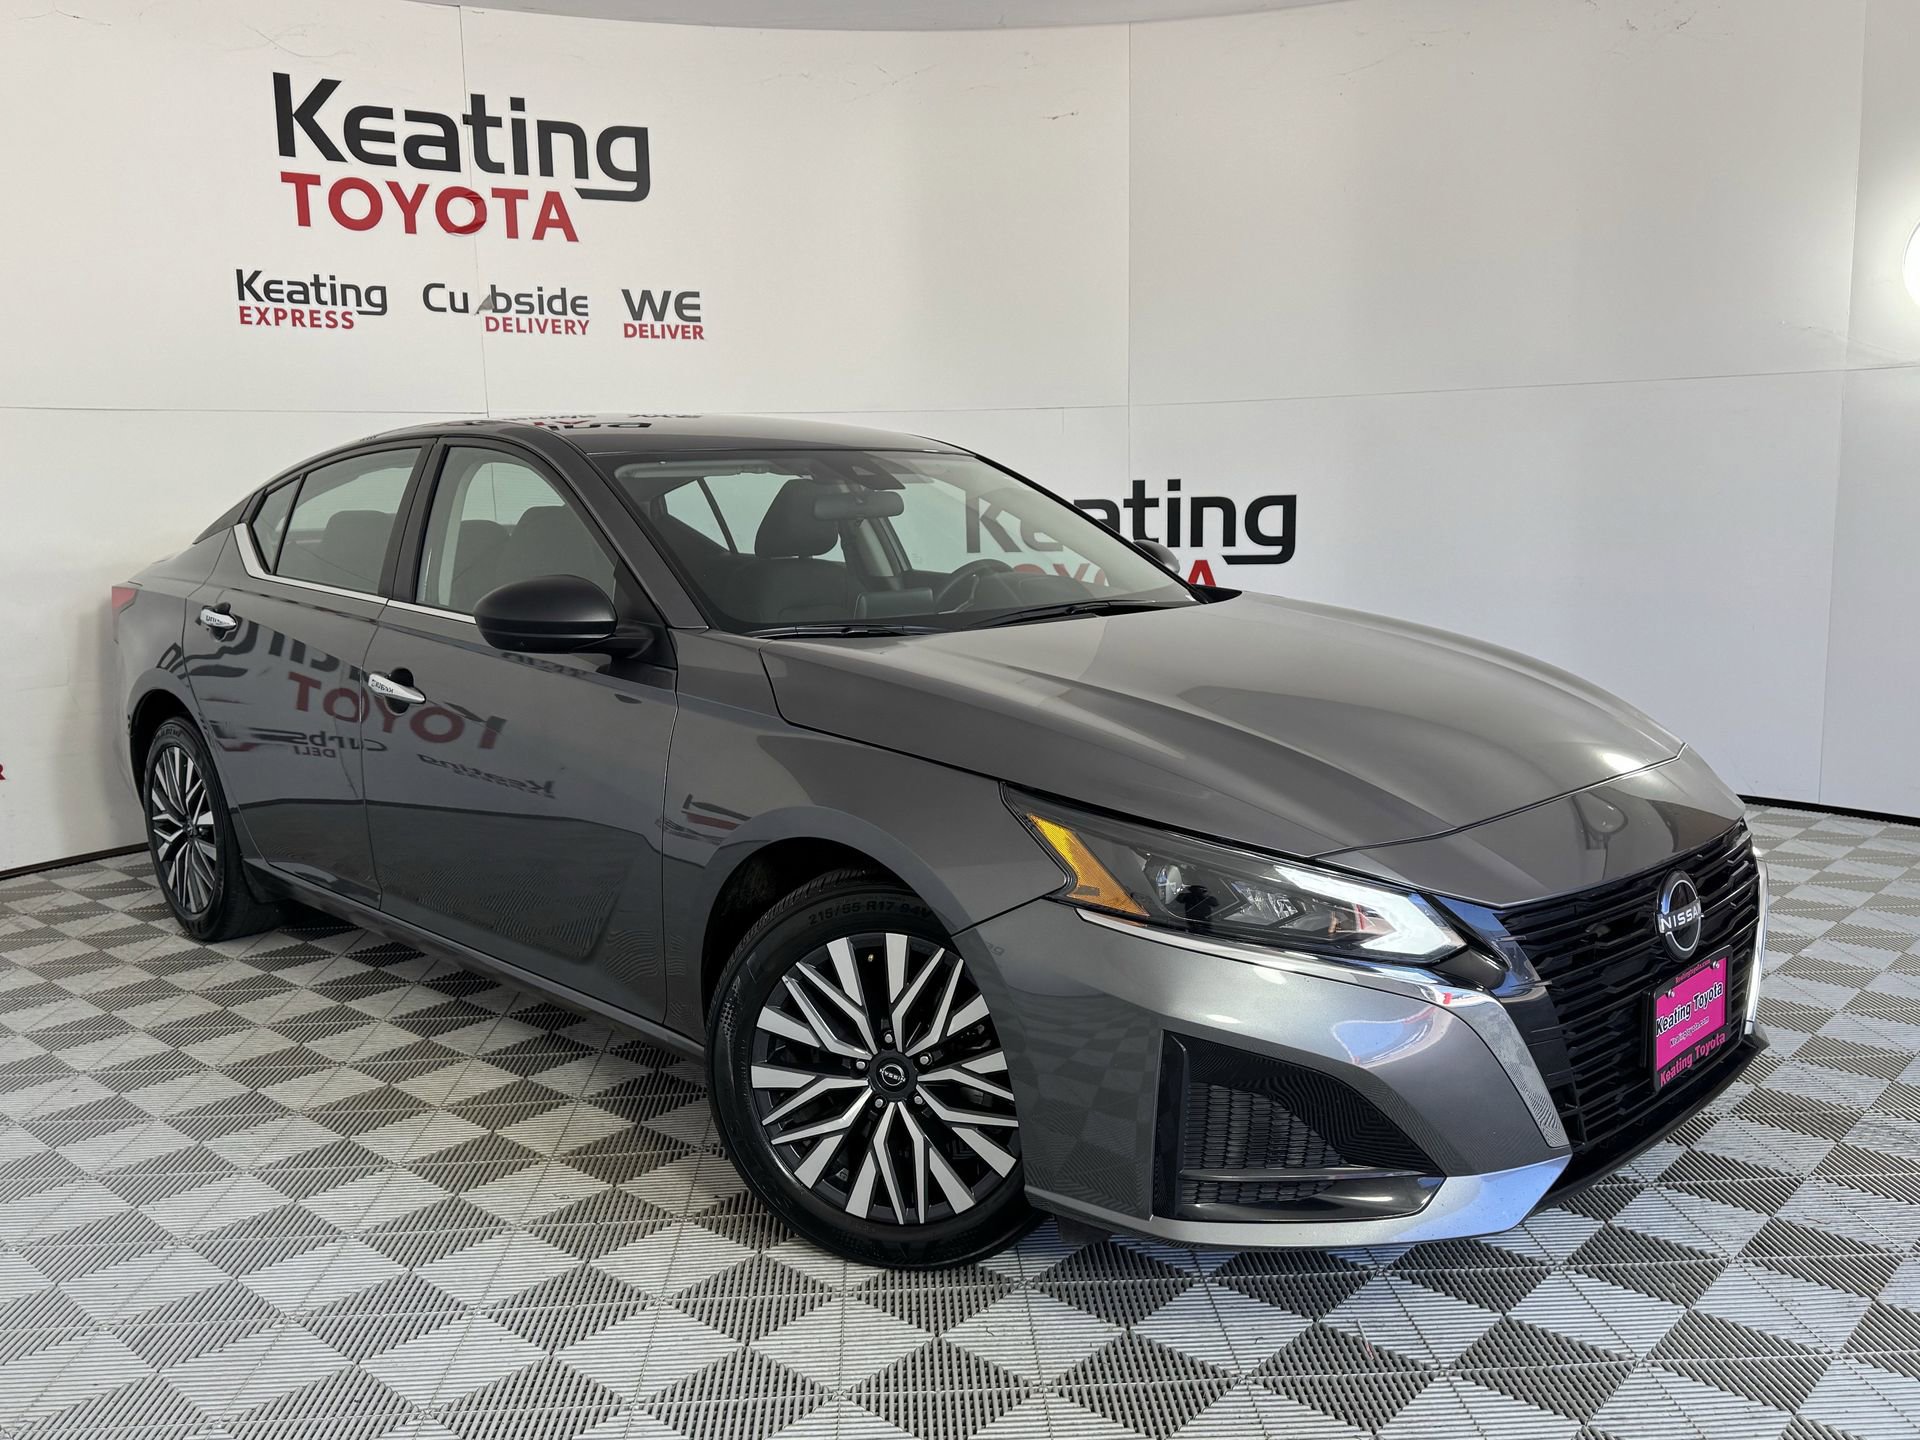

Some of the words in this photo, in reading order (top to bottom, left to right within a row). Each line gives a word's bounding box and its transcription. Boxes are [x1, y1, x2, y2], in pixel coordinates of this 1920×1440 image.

[272, 72, 651, 203] Keating
[280, 171, 579, 243] TOYOTA
[235, 269, 388, 316] Keating
[422, 282, 590, 318] Cubside
[621, 288, 702, 323] WE
[239, 306, 354, 330] EXPRESS
[485, 316, 590, 336] DELIVERY
[623, 322, 705, 341] DELIVER
[808, 902, 861, 926] 215/55
[866, 900, 896, 912] R17
[1655, 1001, 1692, 1037] Keating
[1693, 981, 1724, 1011] Toyota
[1660, 1053, 1693, 1088] Keating
[1694, 1032, 1727, 1060] Toyota
